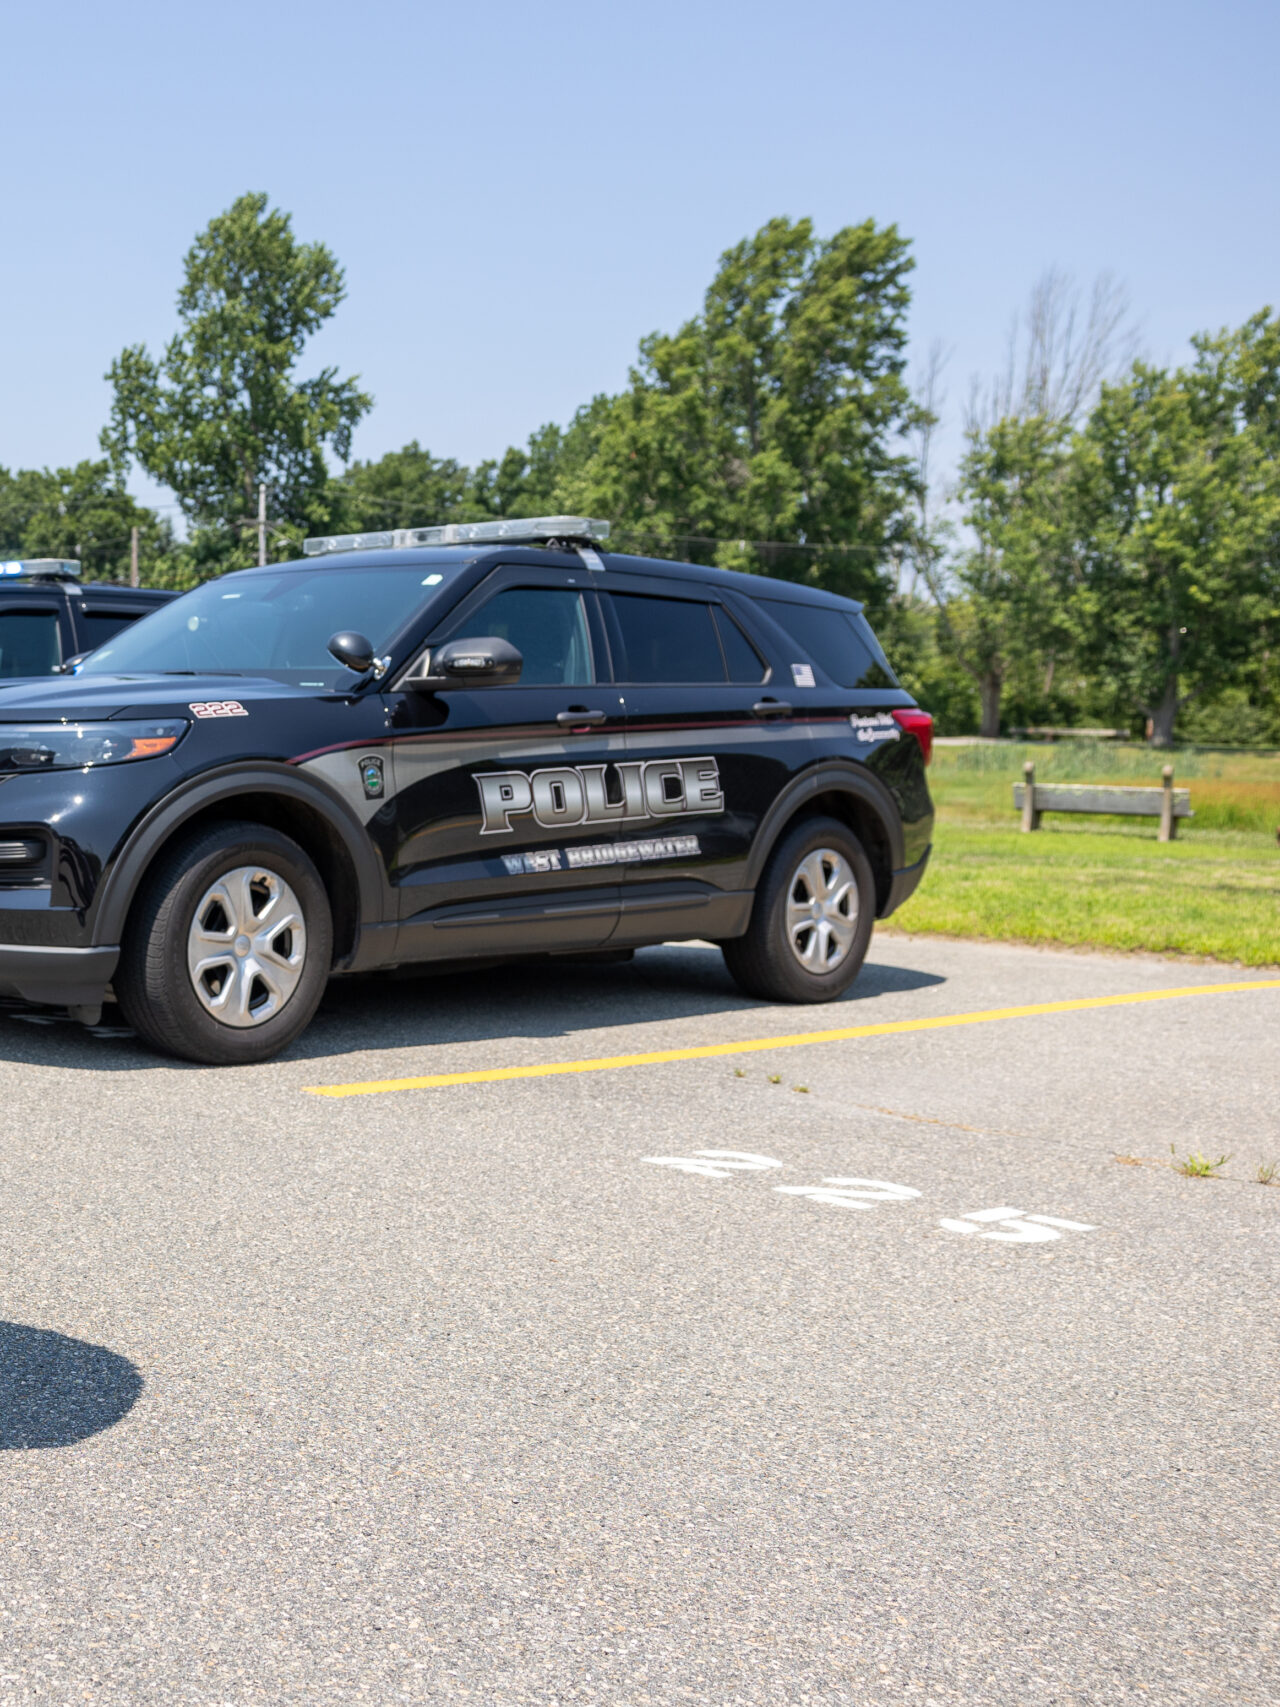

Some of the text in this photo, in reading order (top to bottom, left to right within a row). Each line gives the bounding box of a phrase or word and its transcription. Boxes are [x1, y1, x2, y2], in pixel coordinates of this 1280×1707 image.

[189, 701, 249, 719] 222
[472, 756, 725, 835] POLICE
[501, 835, 702, 875] WEST BRIDGEWATER
